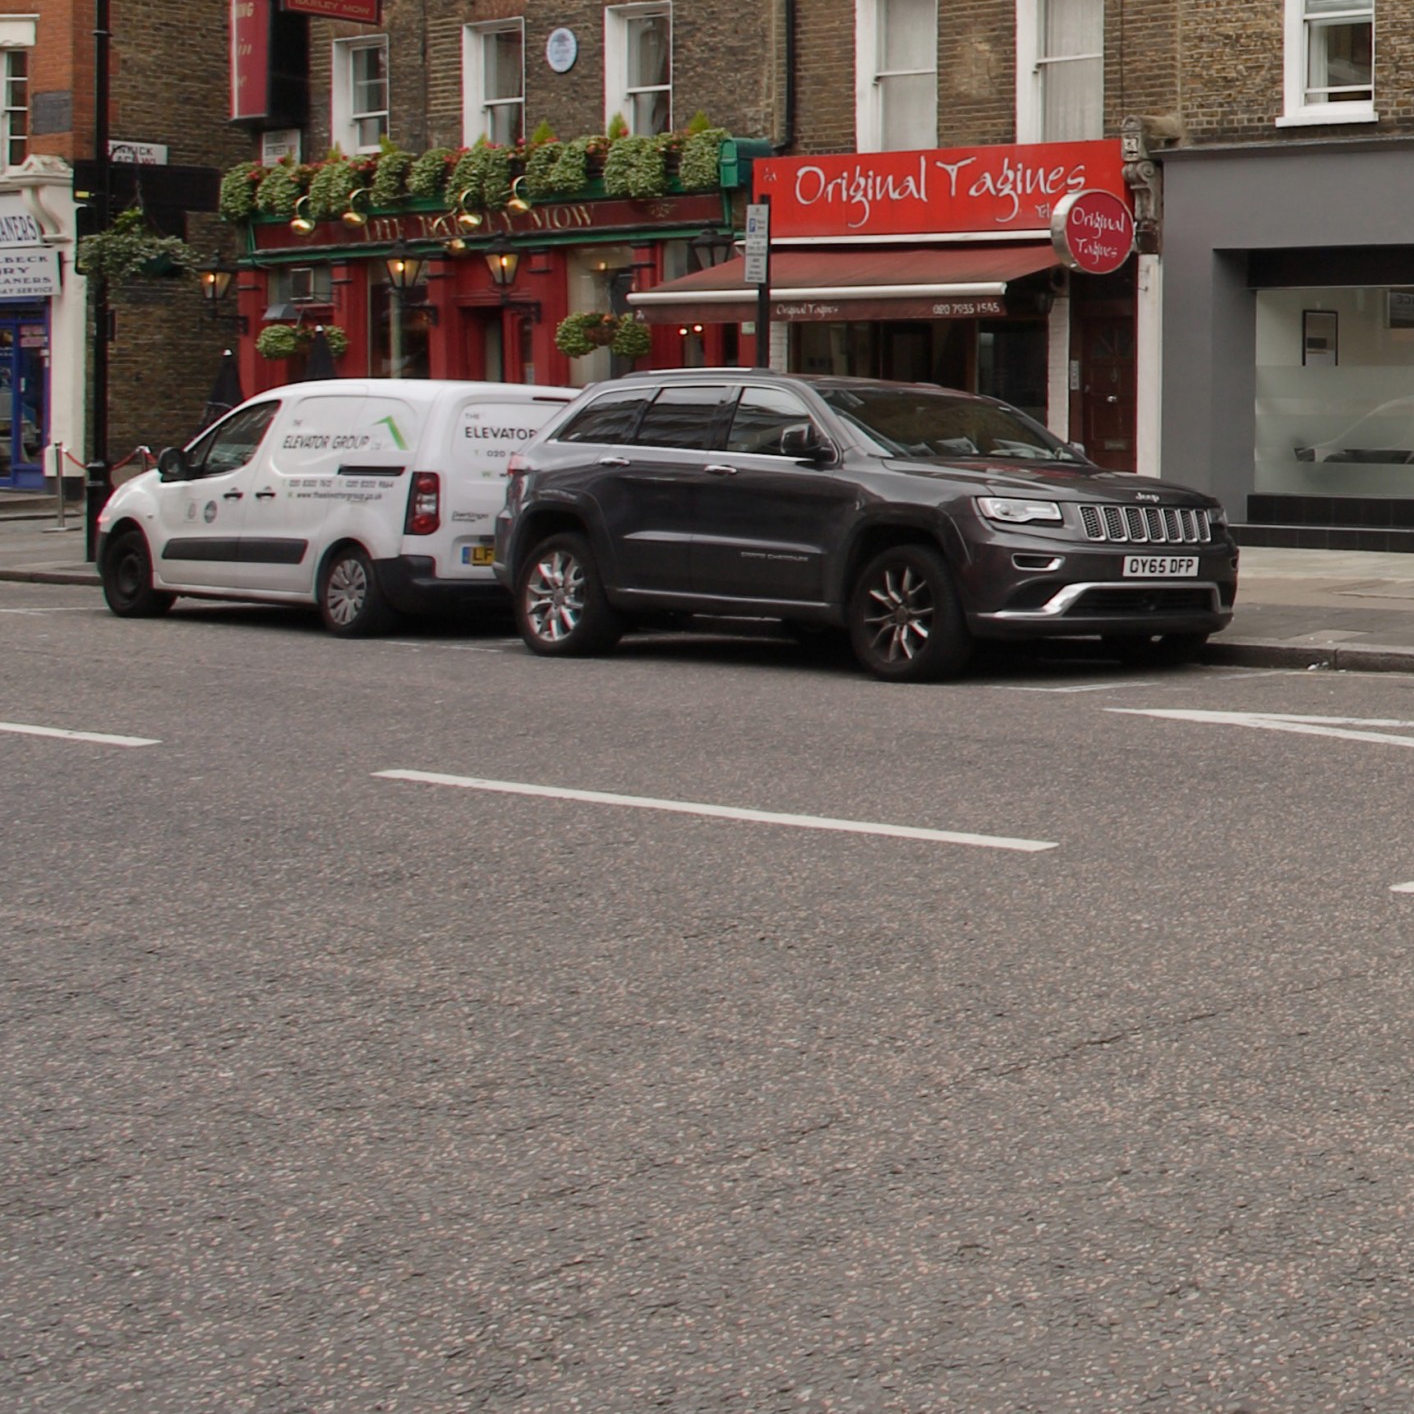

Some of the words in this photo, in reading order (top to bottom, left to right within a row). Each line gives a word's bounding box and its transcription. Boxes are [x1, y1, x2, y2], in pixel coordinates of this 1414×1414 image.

[795, 156, 928, 228] Original
[936, 156, 1087, 223] Tagines
[531, 204, 594, 230] MOW
[1071, 206, 1125, 239] Original
[1075, 237, 1118, 265] Tagines
[0, 255, 48, 264] BECK
[0, 267, 30, 275] RY
[0, 277, 51, 285] ANERS
[17, 286, 53, 294] SERVICE
[776, 302, 806, 319] Original
[808, 302, 839, 319] Tagines
[282, 435, 331, 449] ELEVATOR
[332, 435, 370, 449] GROUP
[1135, 492, 1160, 503] Jeep
[1169, 558, 1194, 574] DFP
